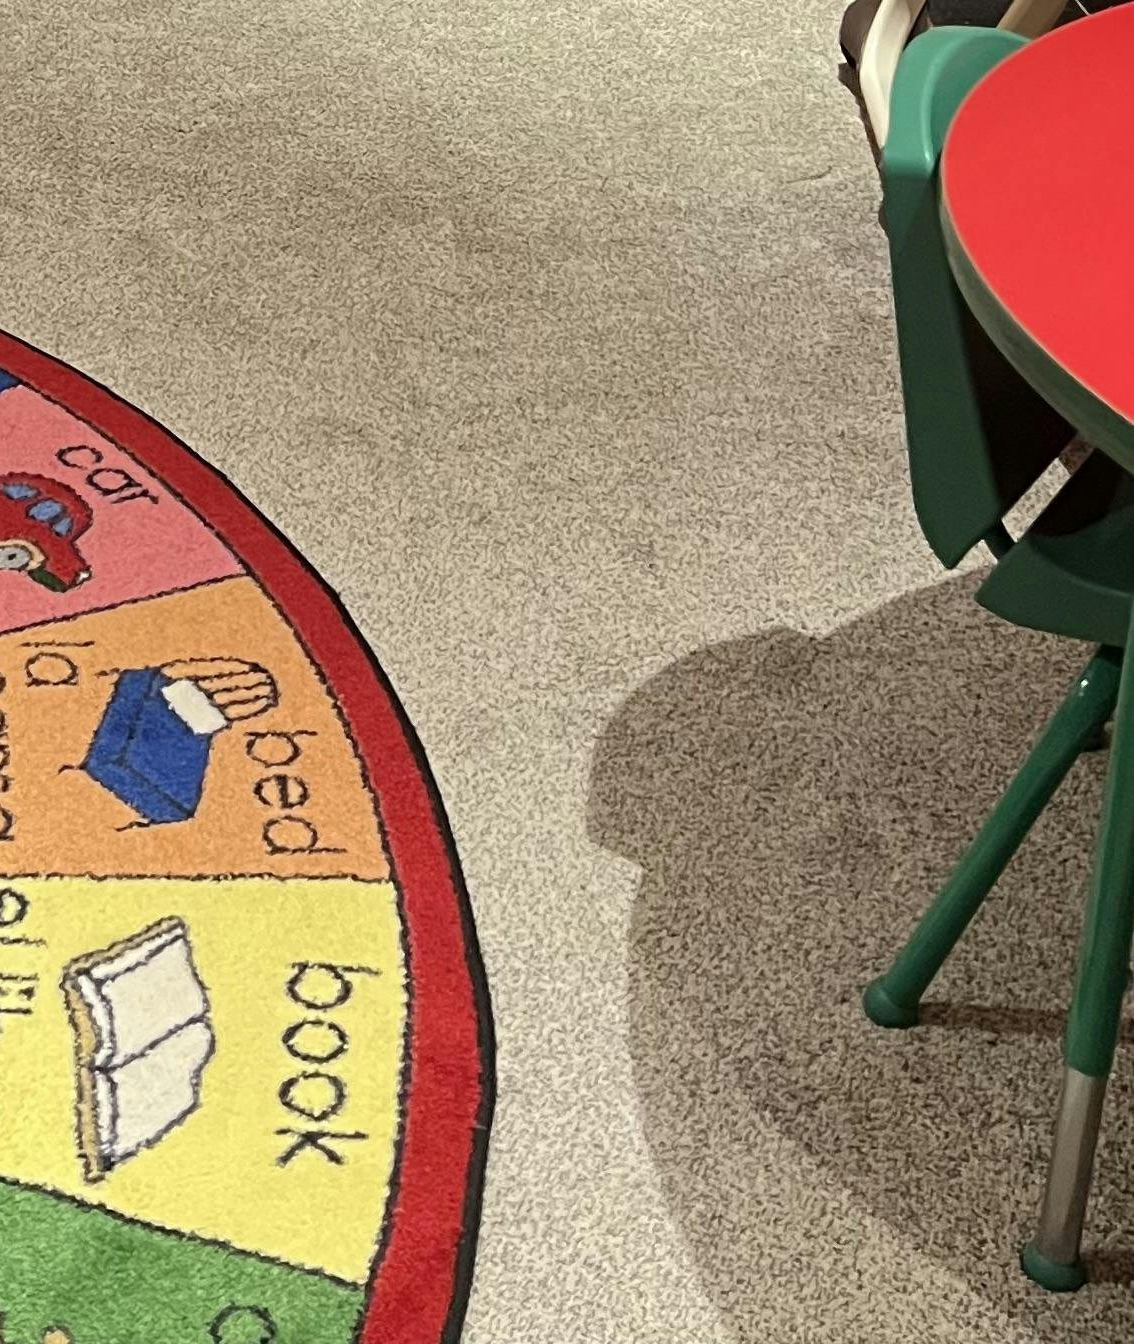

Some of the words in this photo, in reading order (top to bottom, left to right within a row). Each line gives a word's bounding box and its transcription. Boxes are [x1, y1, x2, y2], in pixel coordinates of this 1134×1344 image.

[55, 442, 161, 510] car
[22, 639, 96, 690] la
[245, 728, 349, 855] bed
[276, 959, 382, 1169] book
